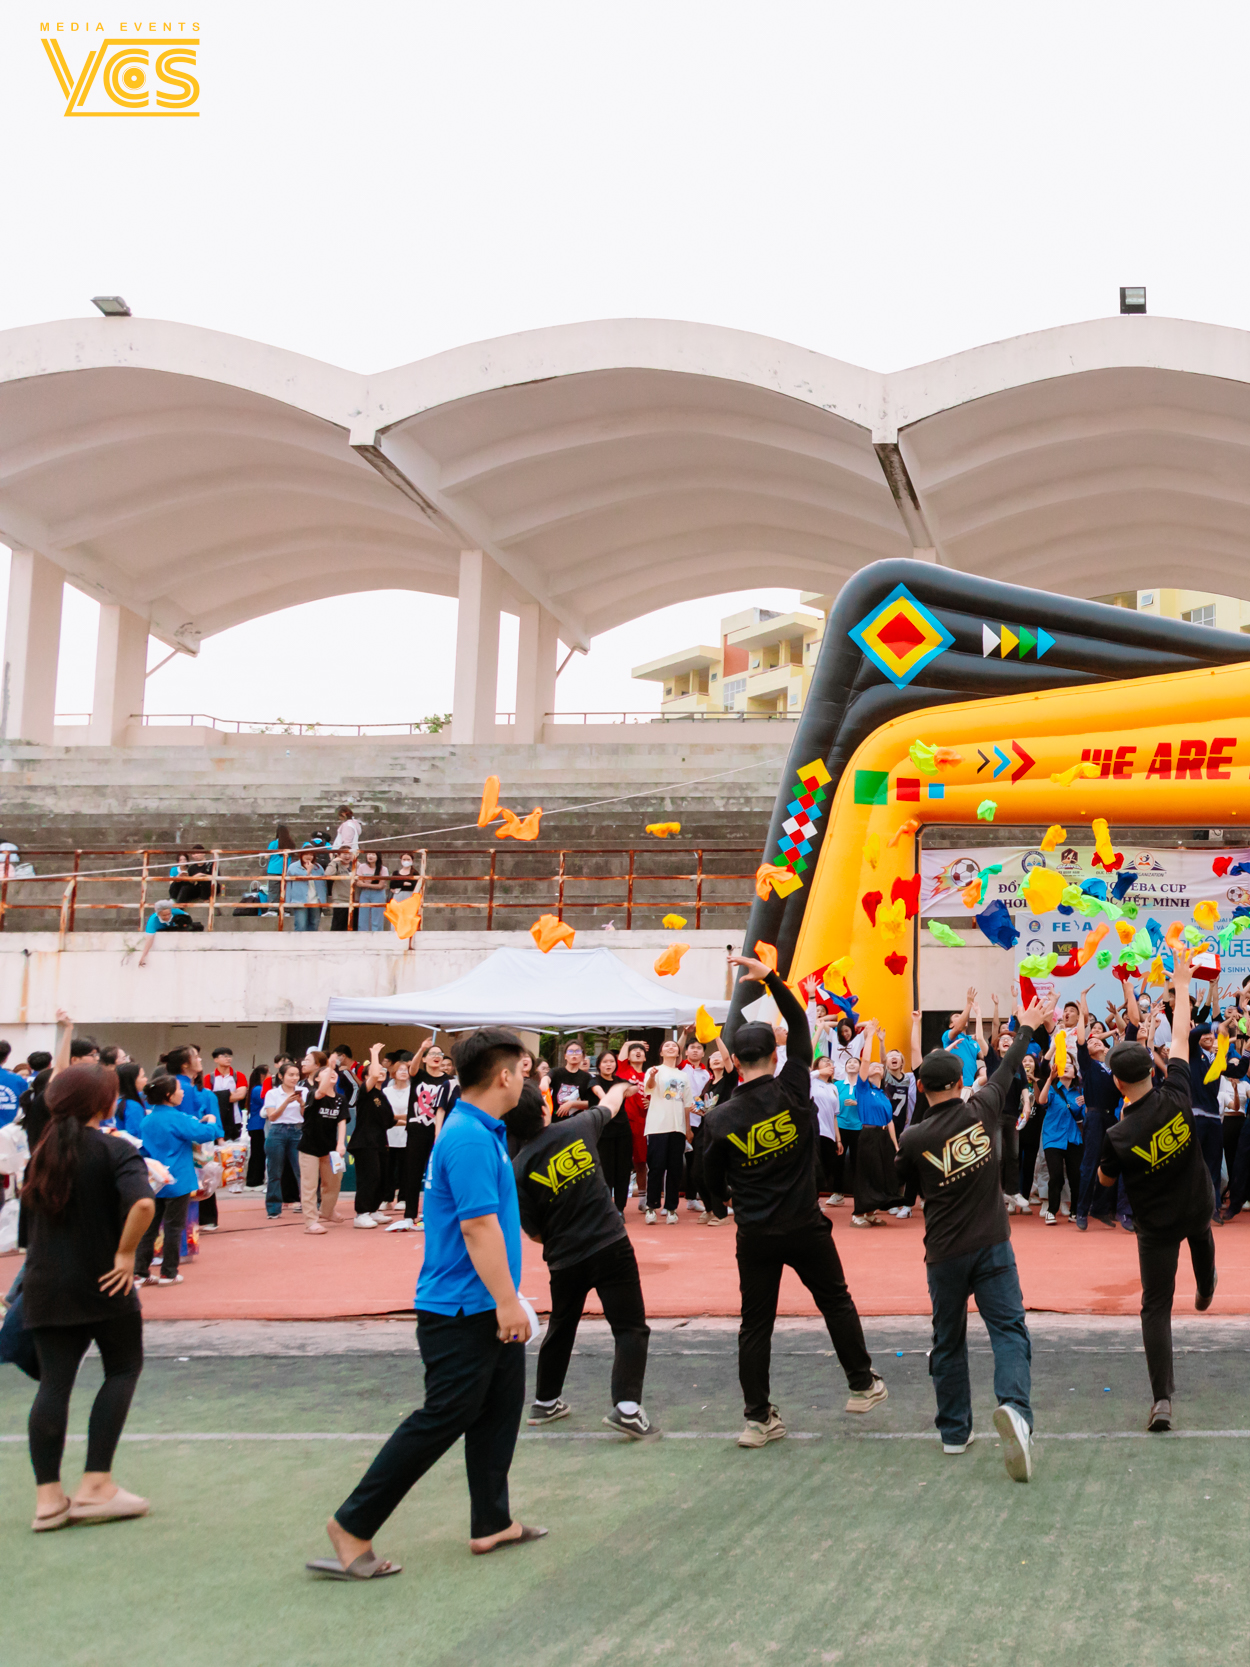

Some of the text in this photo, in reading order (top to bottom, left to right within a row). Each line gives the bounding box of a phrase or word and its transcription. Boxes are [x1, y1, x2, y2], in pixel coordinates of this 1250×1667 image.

[1145, 737, 1237, 780] ARE
[1130, 882, 1157, 893] EBA
[1160, 884, 1187, 893] CUP
[1152, 897, 1190, 908] MÌNH
